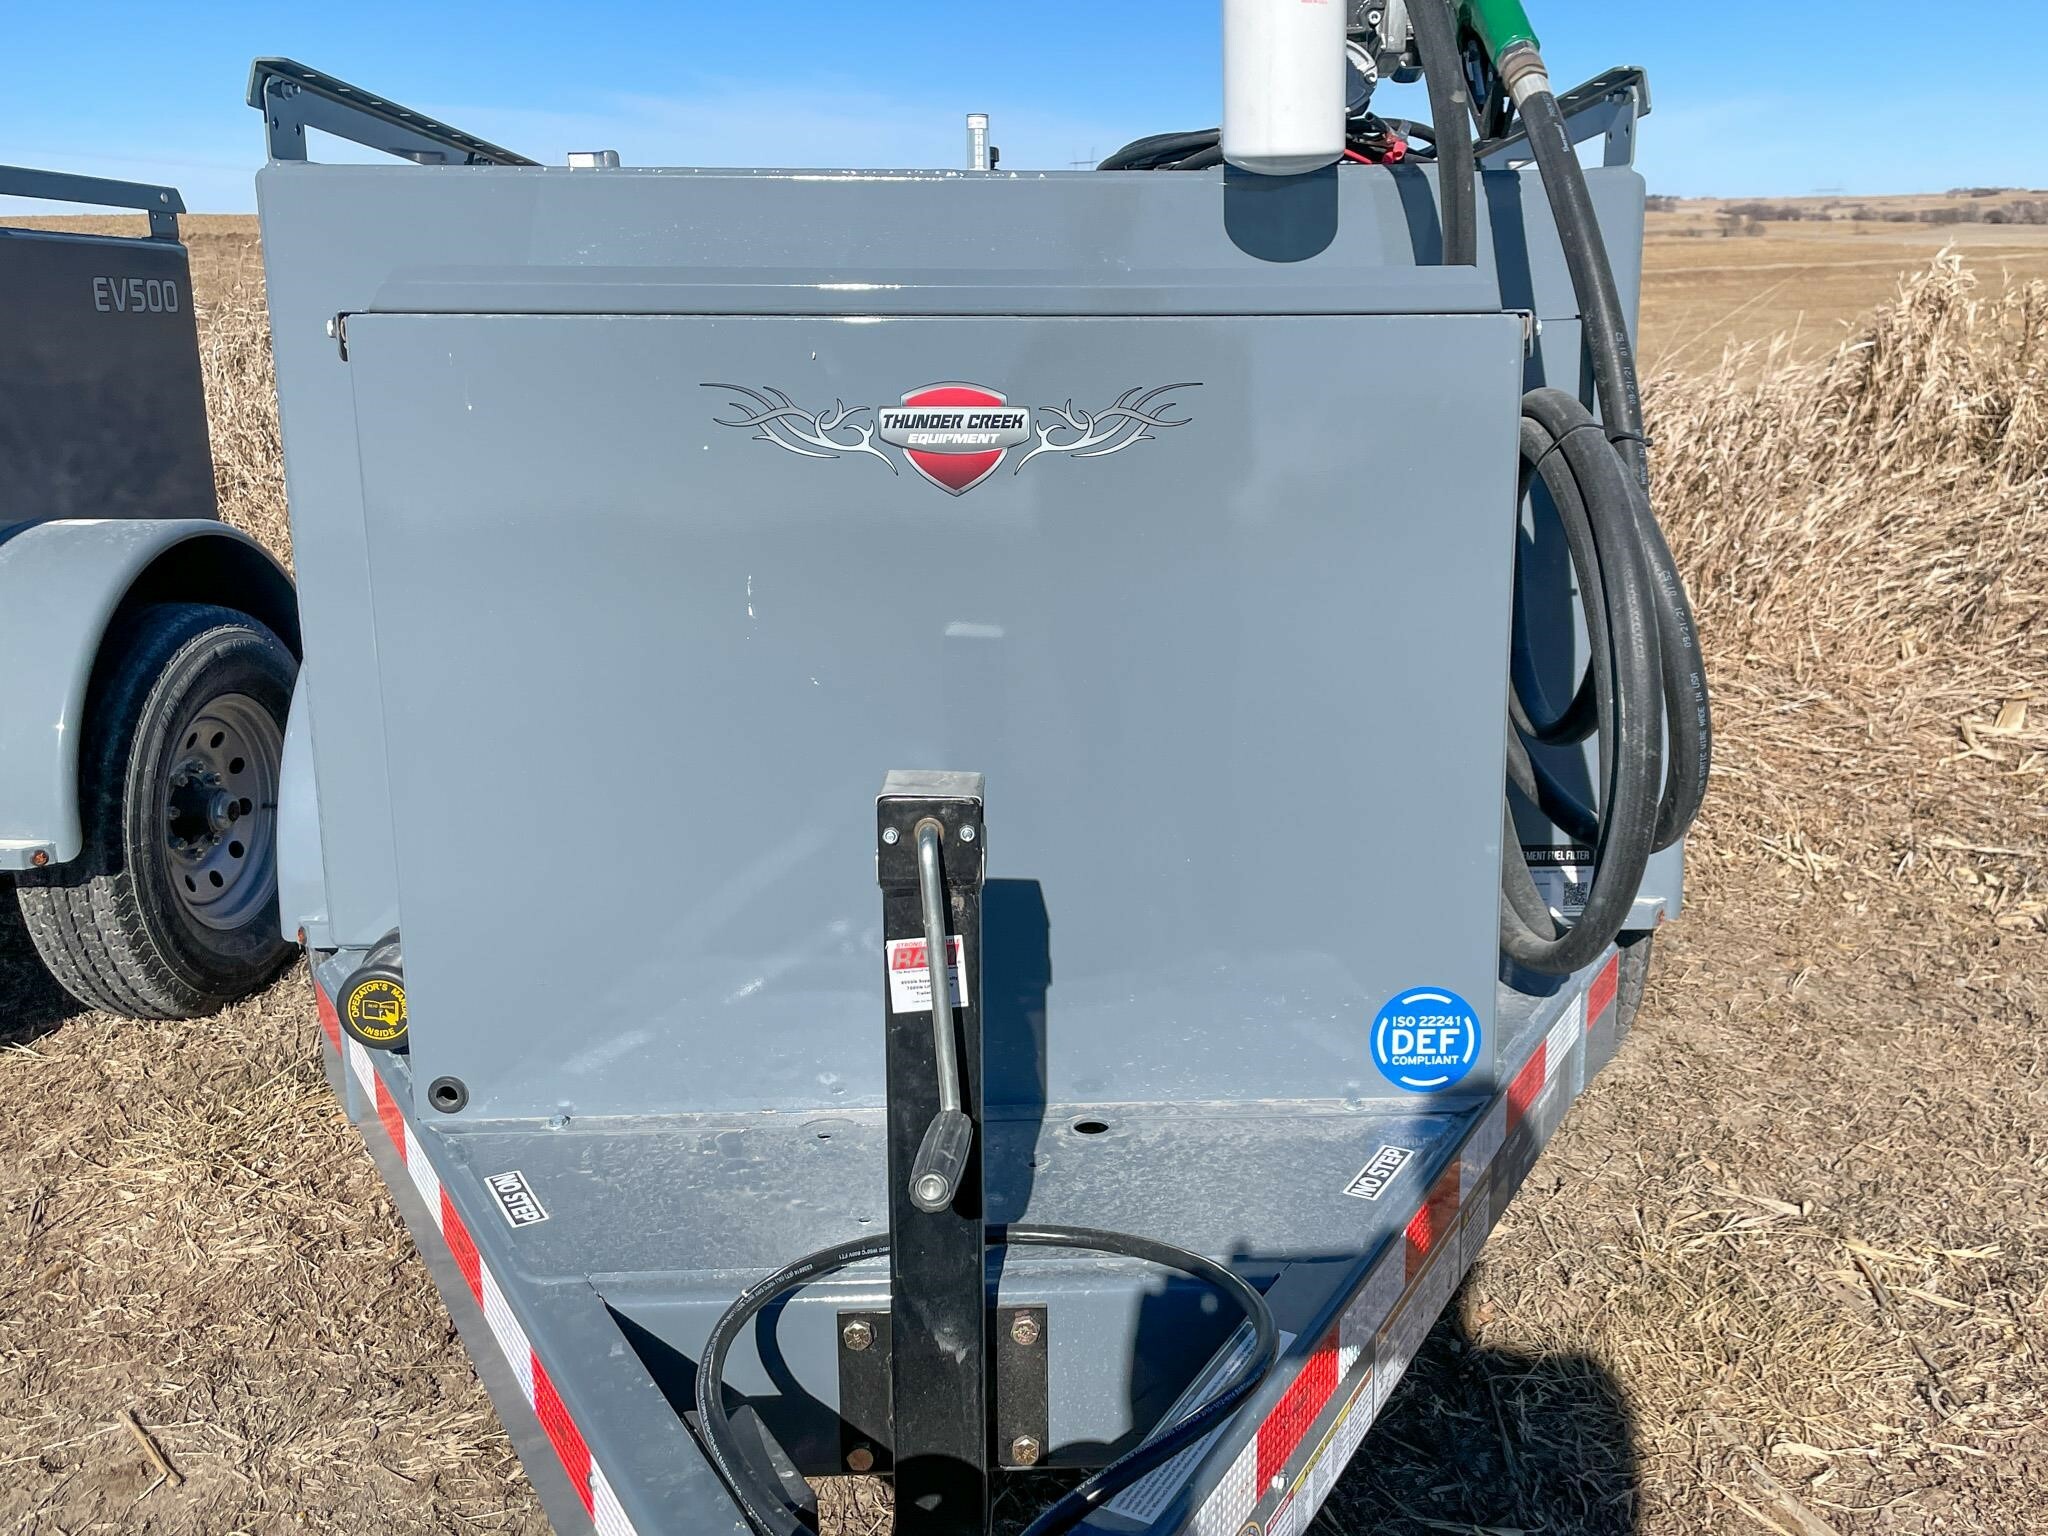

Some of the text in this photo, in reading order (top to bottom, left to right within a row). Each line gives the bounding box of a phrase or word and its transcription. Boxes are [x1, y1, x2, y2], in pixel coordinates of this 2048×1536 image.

[93, 277, 179, 313] EV500
[883, 414, 1024, 428] THUNDER CREEK
[907, 433, 1000, 444] EQUIPMENT
[1674, 607, 1692, 648] 09/21/21
[1690, 672, 1700, 688] USA
[1548, 851, 1565, 860] FUEL
[1566, 851, 1589, 860] FILTER
[352, 983, 388, 1018] OPERATOR'S
[1392, 1016, 1461, 1027] ISO 22241
[364, 1025, 396, 1037] INSIDE
[1391, 1028, 1460, 1055] DEF
[1391, 1055, 1460, 1065] COMPLIANT
[1350, 1148, 1404, 1197] NO STEP
[492, 1174, 541, 1221] NO STEP
